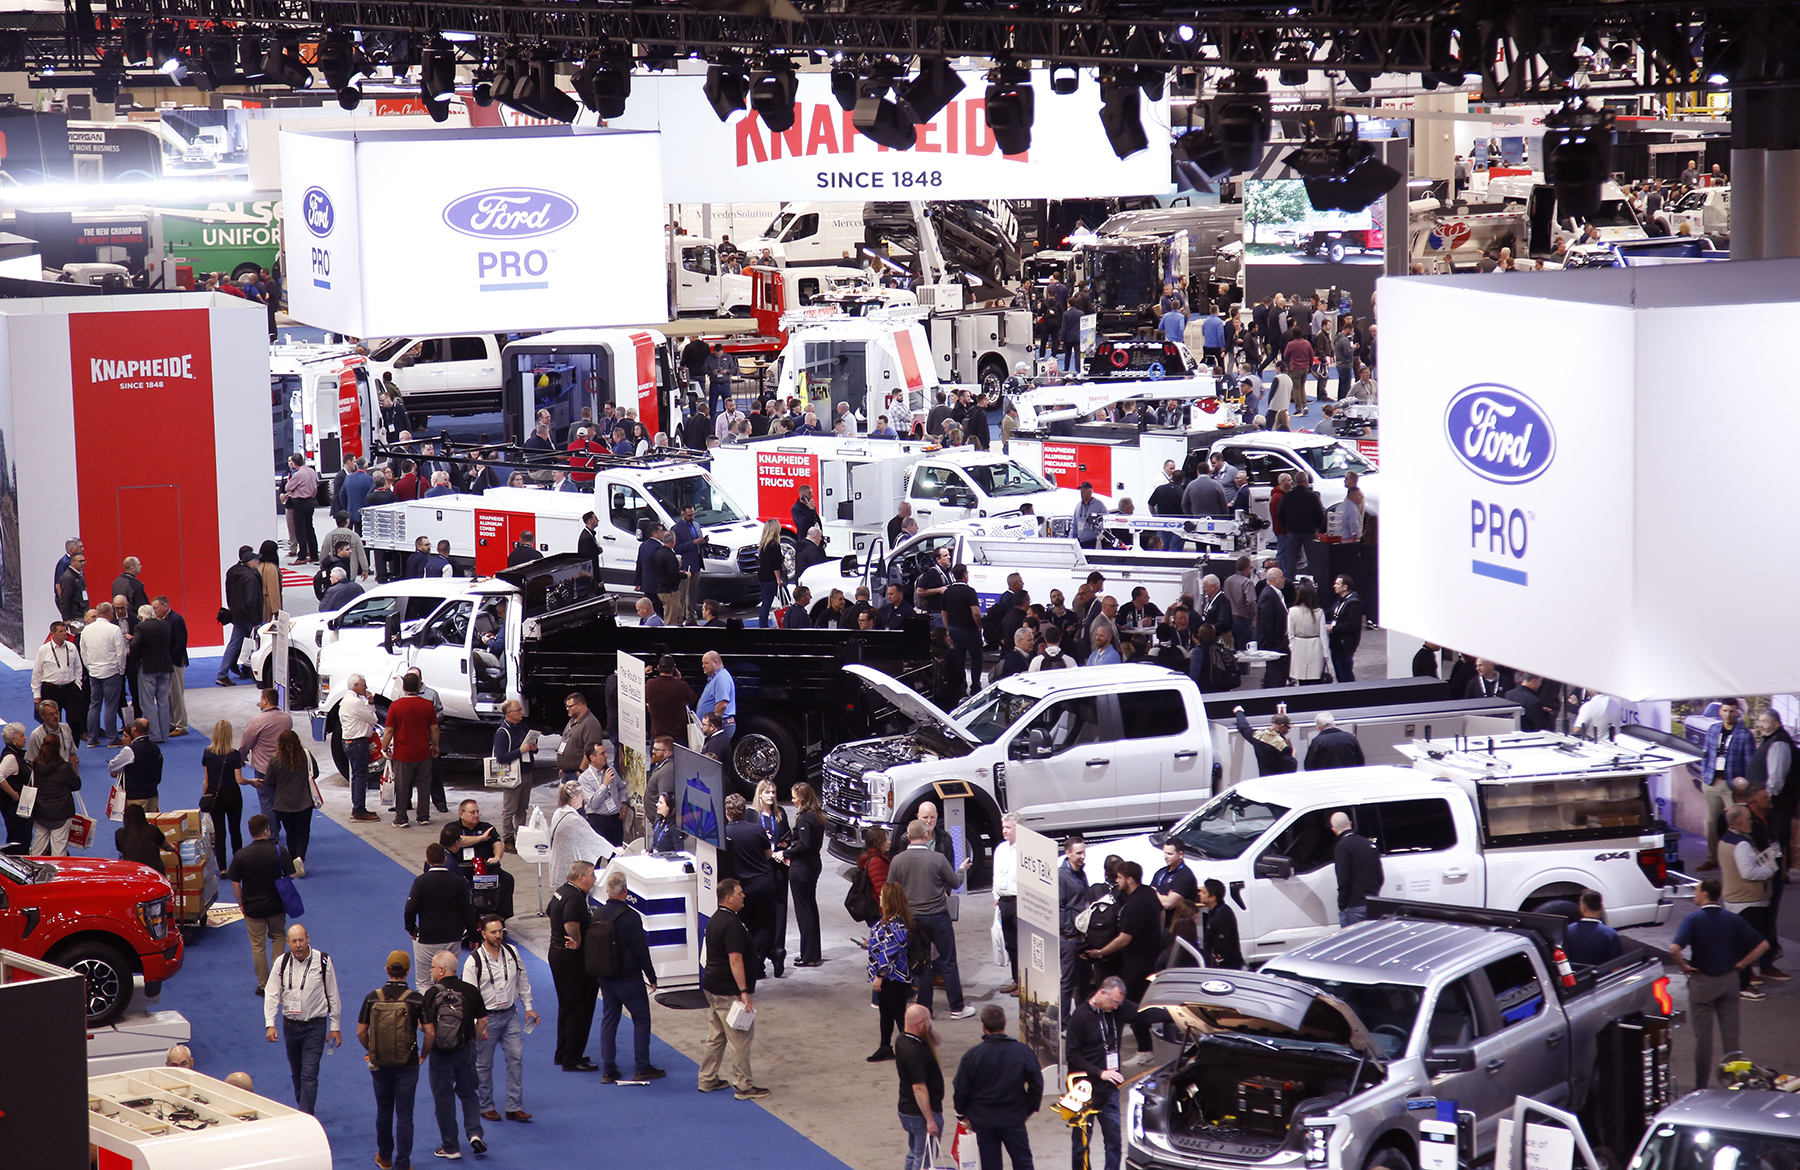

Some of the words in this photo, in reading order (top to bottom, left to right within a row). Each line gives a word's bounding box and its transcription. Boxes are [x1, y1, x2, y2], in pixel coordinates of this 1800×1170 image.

[817, 171, 884, 188] SINCE
[892, 171, 943, 187] 1848
[470, 195, 551, 230] Ford
[84, 228, 95, 236] THE
[96, 228, 109, 236] NEW
[111, 226, 142, 235] CHAMPION
[87, 236, 109, 244] SPEEDY
[111, 236, 142, 244] DELIVERIES
[312, 247, 330, 276] PRO
[478, 249, 548, 278] PRO
[90, 354, 193, 383] KNAPHEIDE
[120, 382, 144, 390] SINCE
[146, 381, 164, 389] 1848
[1463, 397, 1534, 468] Ford
[759, 455, 810, 465] KNAPHEIDE
[759, 466, 786, 476] STEEL
[788, 467, 811, 477] LUBE
[759, 477, 794, 488] TRUCKS
[1471, 499, 1528, 559] PRO
[1020, 851, 1036, 873] Let's
